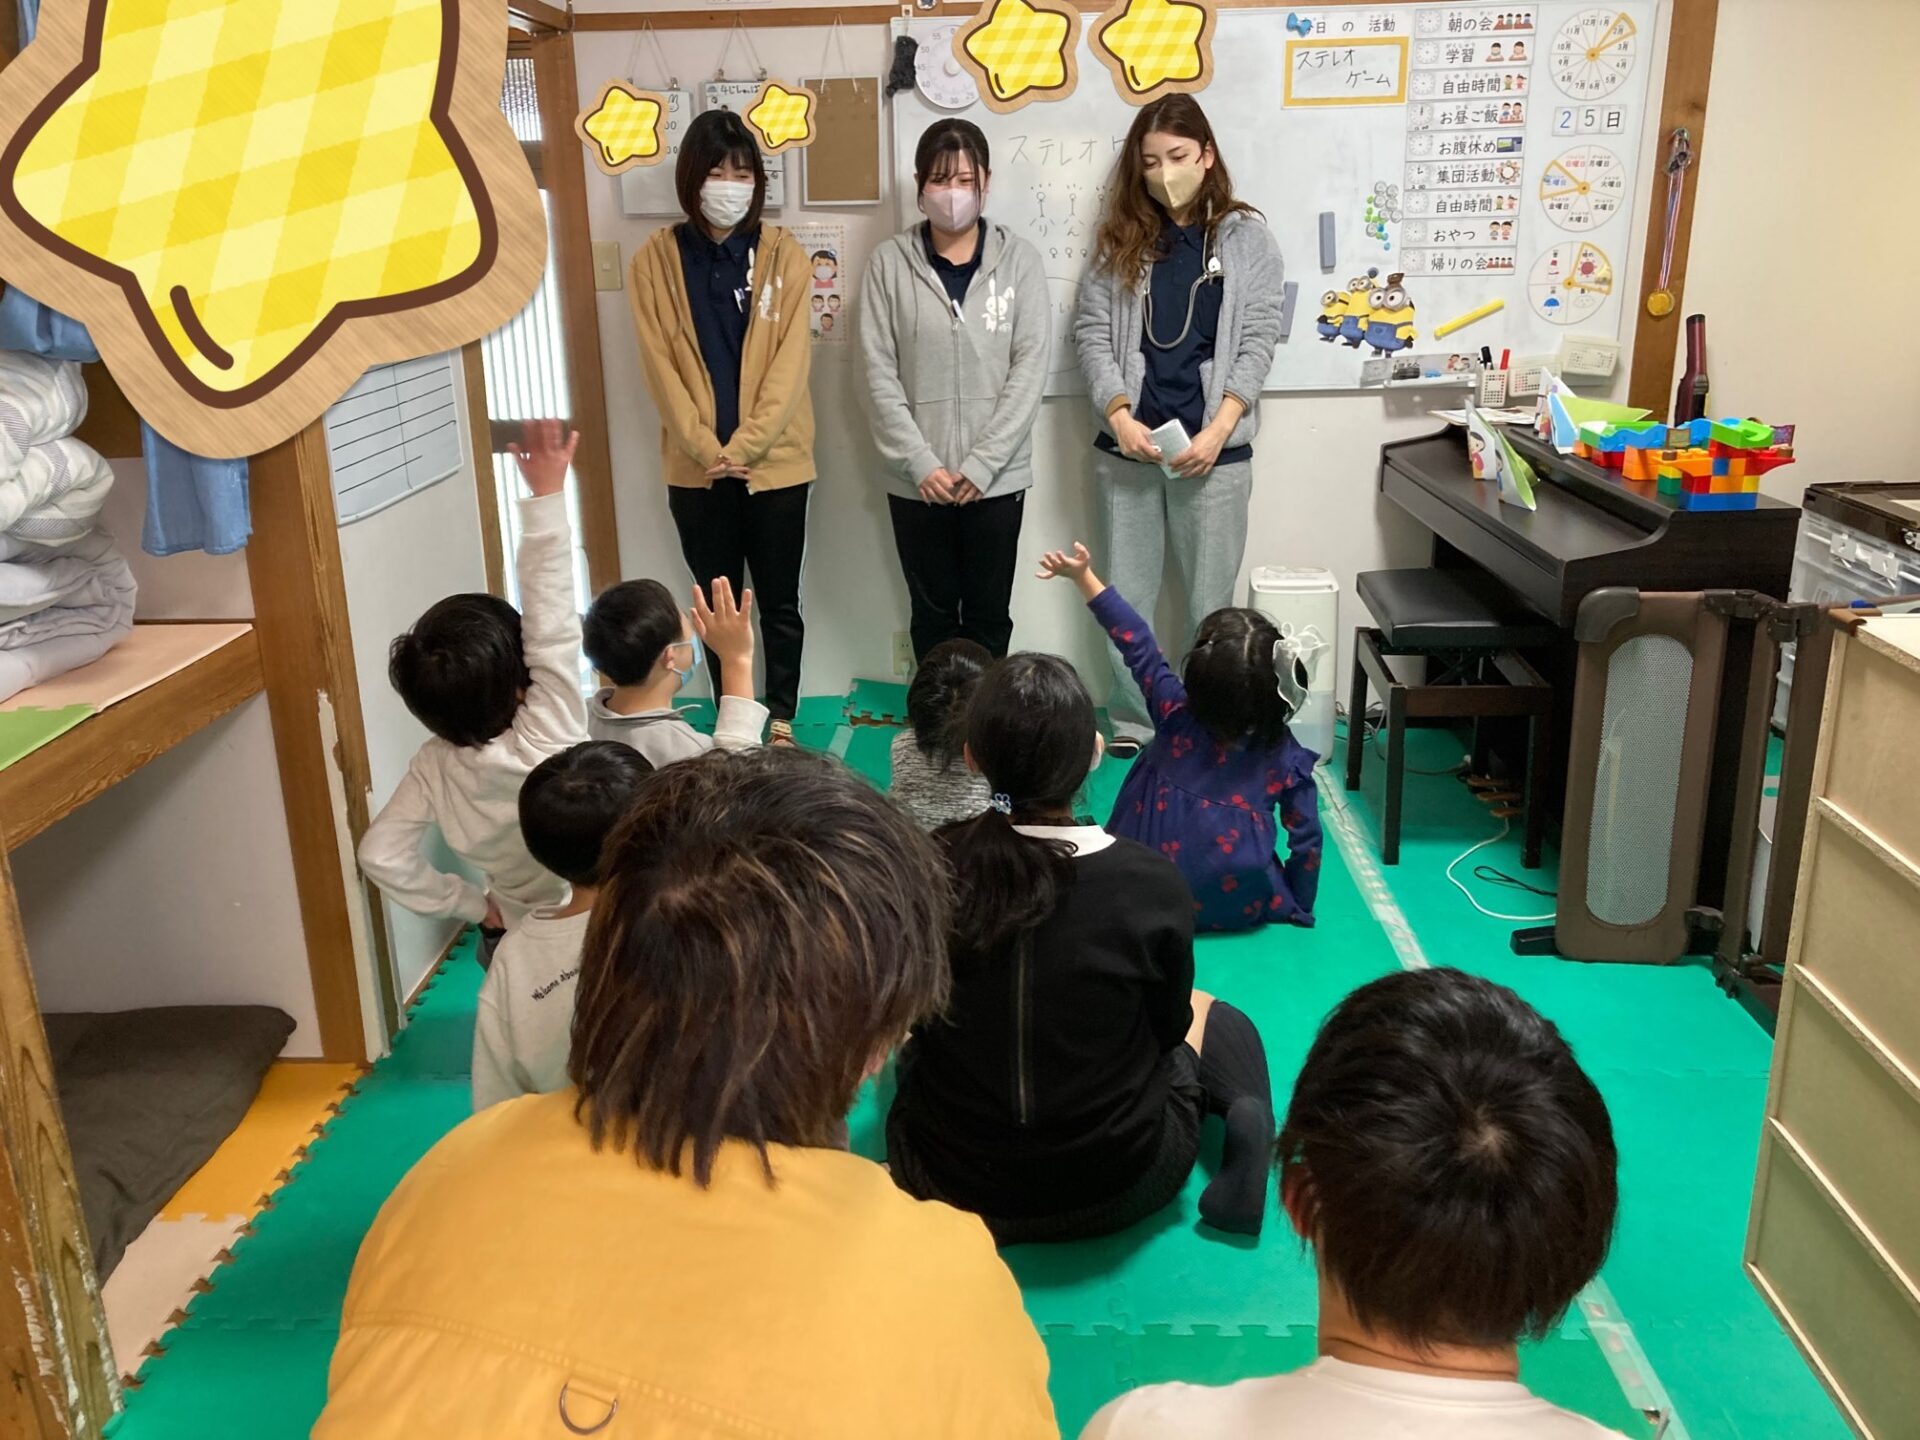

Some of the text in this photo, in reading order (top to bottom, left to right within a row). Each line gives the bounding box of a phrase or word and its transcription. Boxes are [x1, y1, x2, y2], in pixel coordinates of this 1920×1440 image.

[1342, 21, 1354, 33] の
[1369, 18, 1396, 33] 活動
[1448, 16, 1493, 33] 朝の会
[1296, 49, 1356, 70] ステレオ
[1446, 48, 1474, 64] 学習
[1345, 70, 1391, 88] ゲーム
[1443, 77, 1501, 94] 自由時間
[1440, 109, 1498, 125] お昼ご飯
[1439, 140, 1496, 155] お腹休め
[1436, 169, 1495, 184] 集団活動
[1436, 198, 1492, 214] 自由時間
[1433, 229, 1476, 242] おやつ
[1431, 257, 1488, 271] 帰りの会
